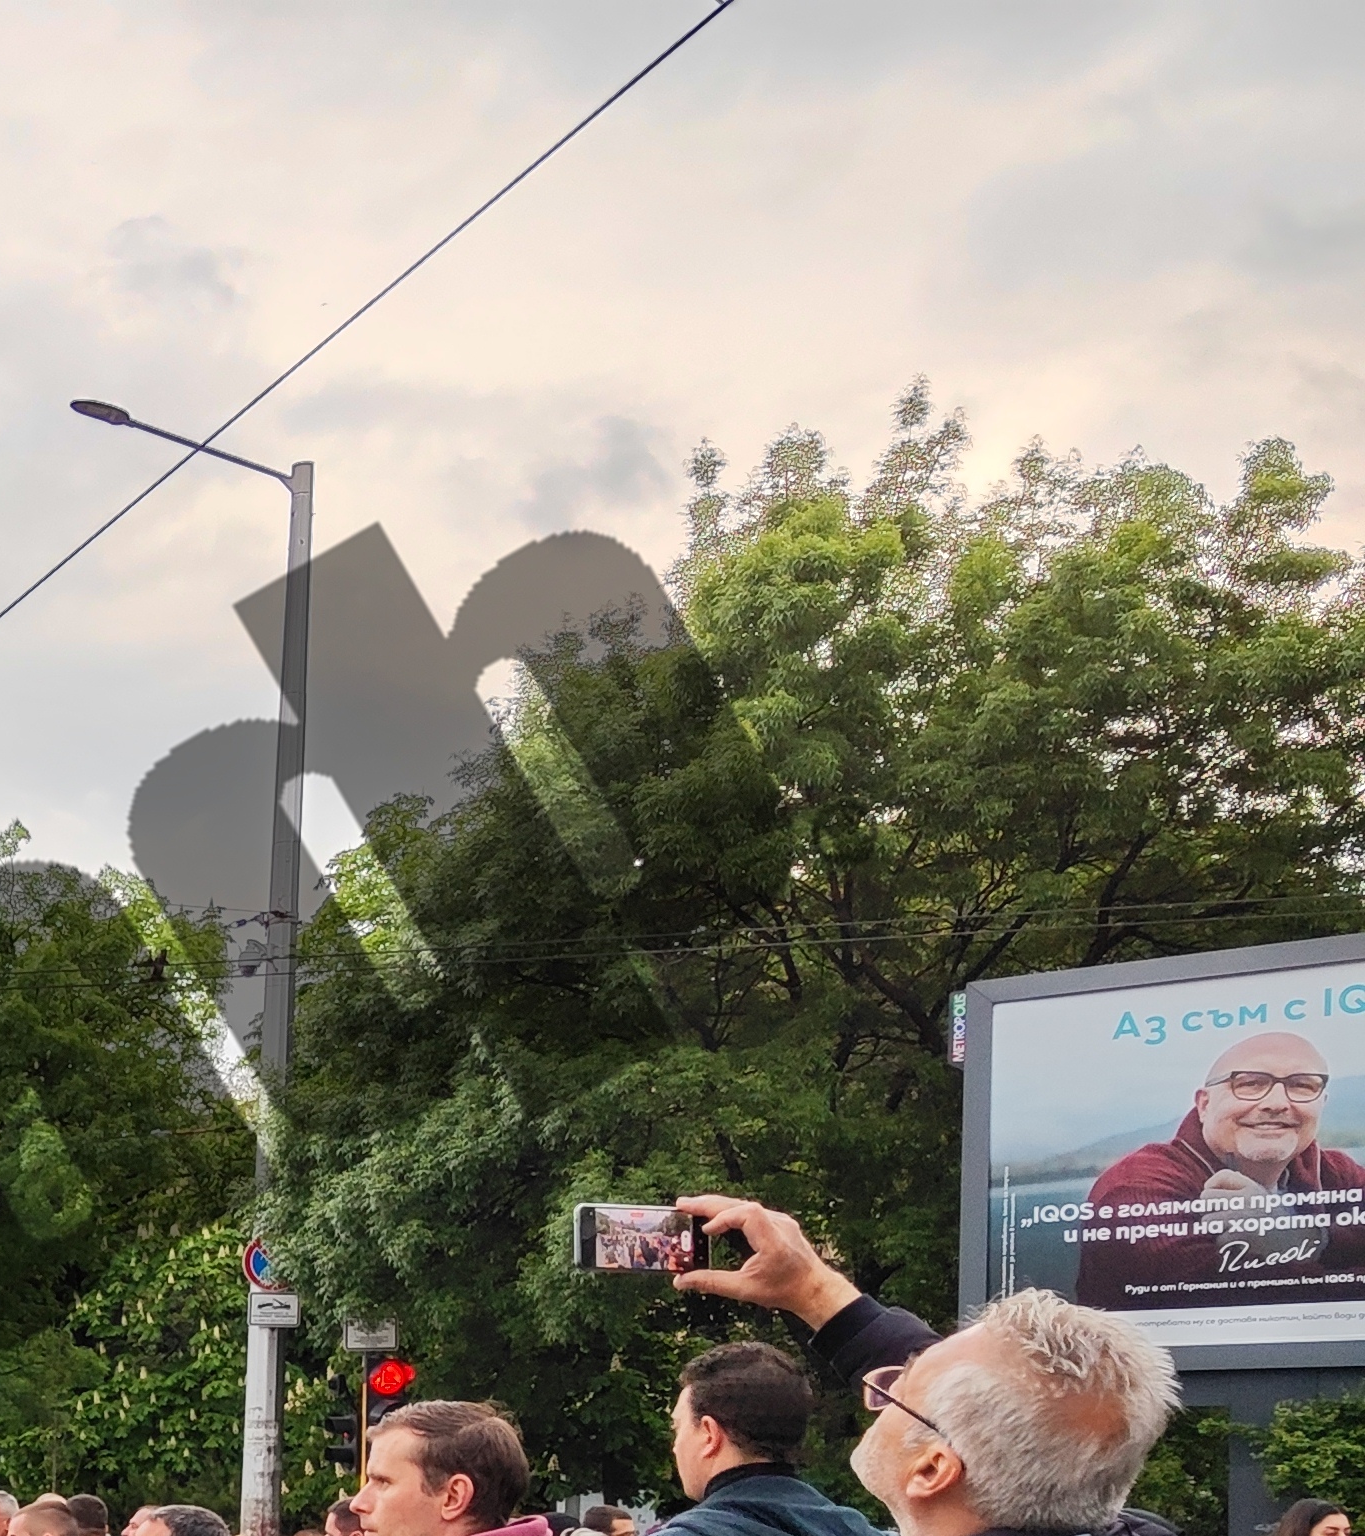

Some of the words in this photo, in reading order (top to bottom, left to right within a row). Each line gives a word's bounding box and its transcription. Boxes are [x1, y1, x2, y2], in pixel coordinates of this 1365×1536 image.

[952, 993, 967, 1063] METROPOLIS
[1112, 1011, 1166, 1045] Аз
[1181, 1003, 1267, 1032] съм
[1098, 1205, 1114, 1219] е
[1117, 1196, 1245, 1218] голямата
[1250, 1188, 1363, 1213] промяна
[1063, 1229, 1078, 1243] и
[1082, 1227, 1111, 1242] не
[1115, 1222, 1189, 1244] пречи
[1193, 1219, 1224, 1235] на
[1228, 1213, 1331, 1236] хората
[1125, 1284, 1150, 1295] Руди
[1178, 1281, 1229, 1292] Германия
[1247, 1278, 1300, 1289] преминал
[1302, 1276, 1323, 1284] към
[1325, 1273, 1355, 1283] IQOS
